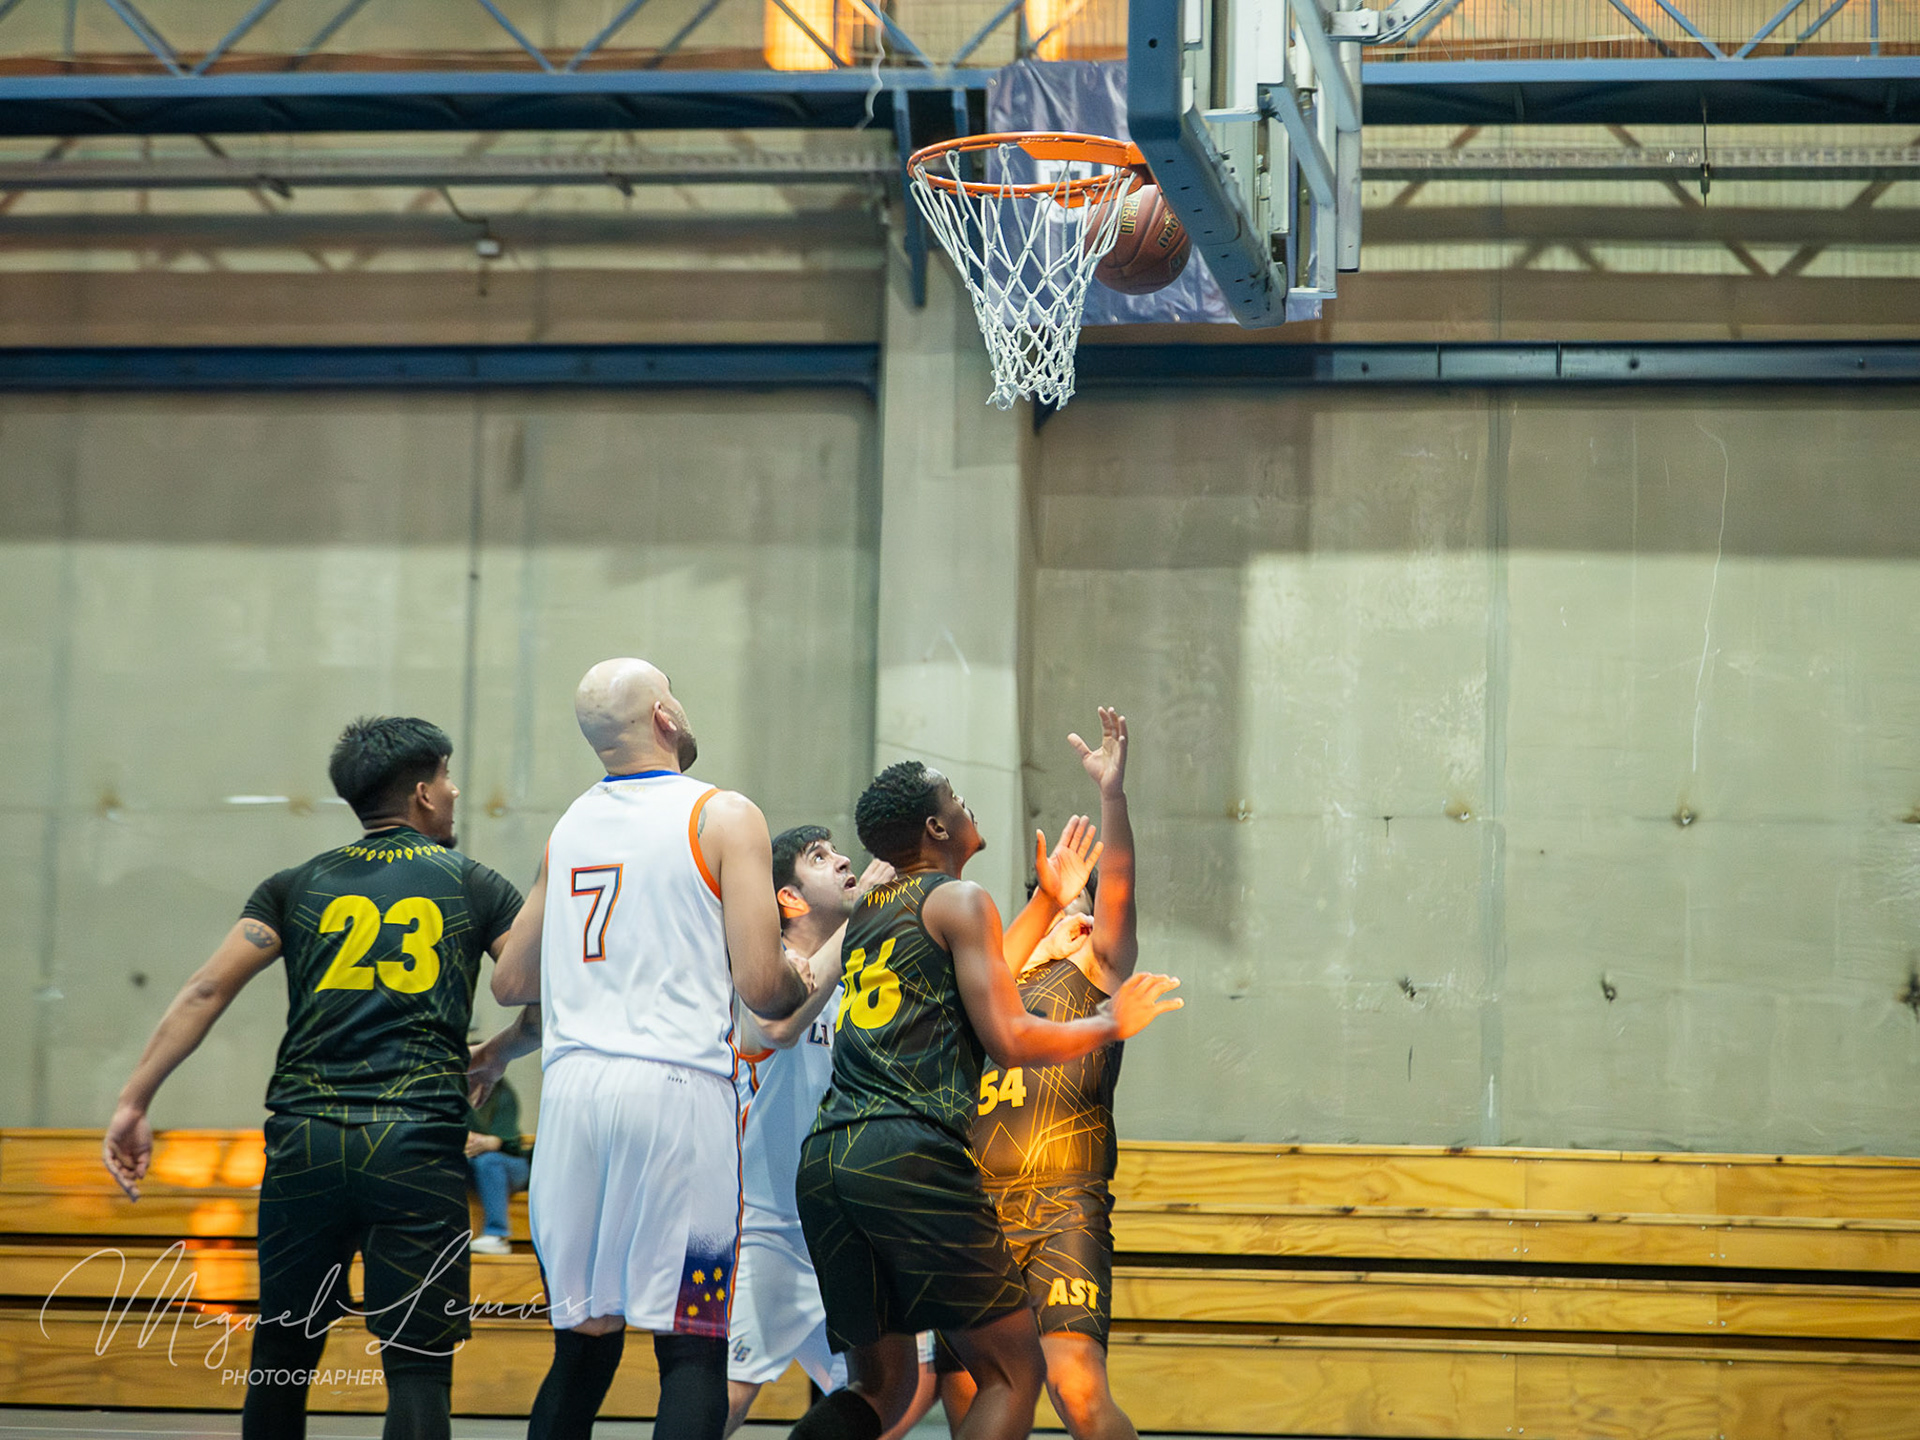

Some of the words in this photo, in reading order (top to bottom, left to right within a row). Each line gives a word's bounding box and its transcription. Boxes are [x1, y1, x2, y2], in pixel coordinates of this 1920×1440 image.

[314, 895, 444, 994] 23
[571, 863, 624, 963] 7
[978, 1066, 1027, 1116] 54
[1048, 1278, 1099, 1309] AST
